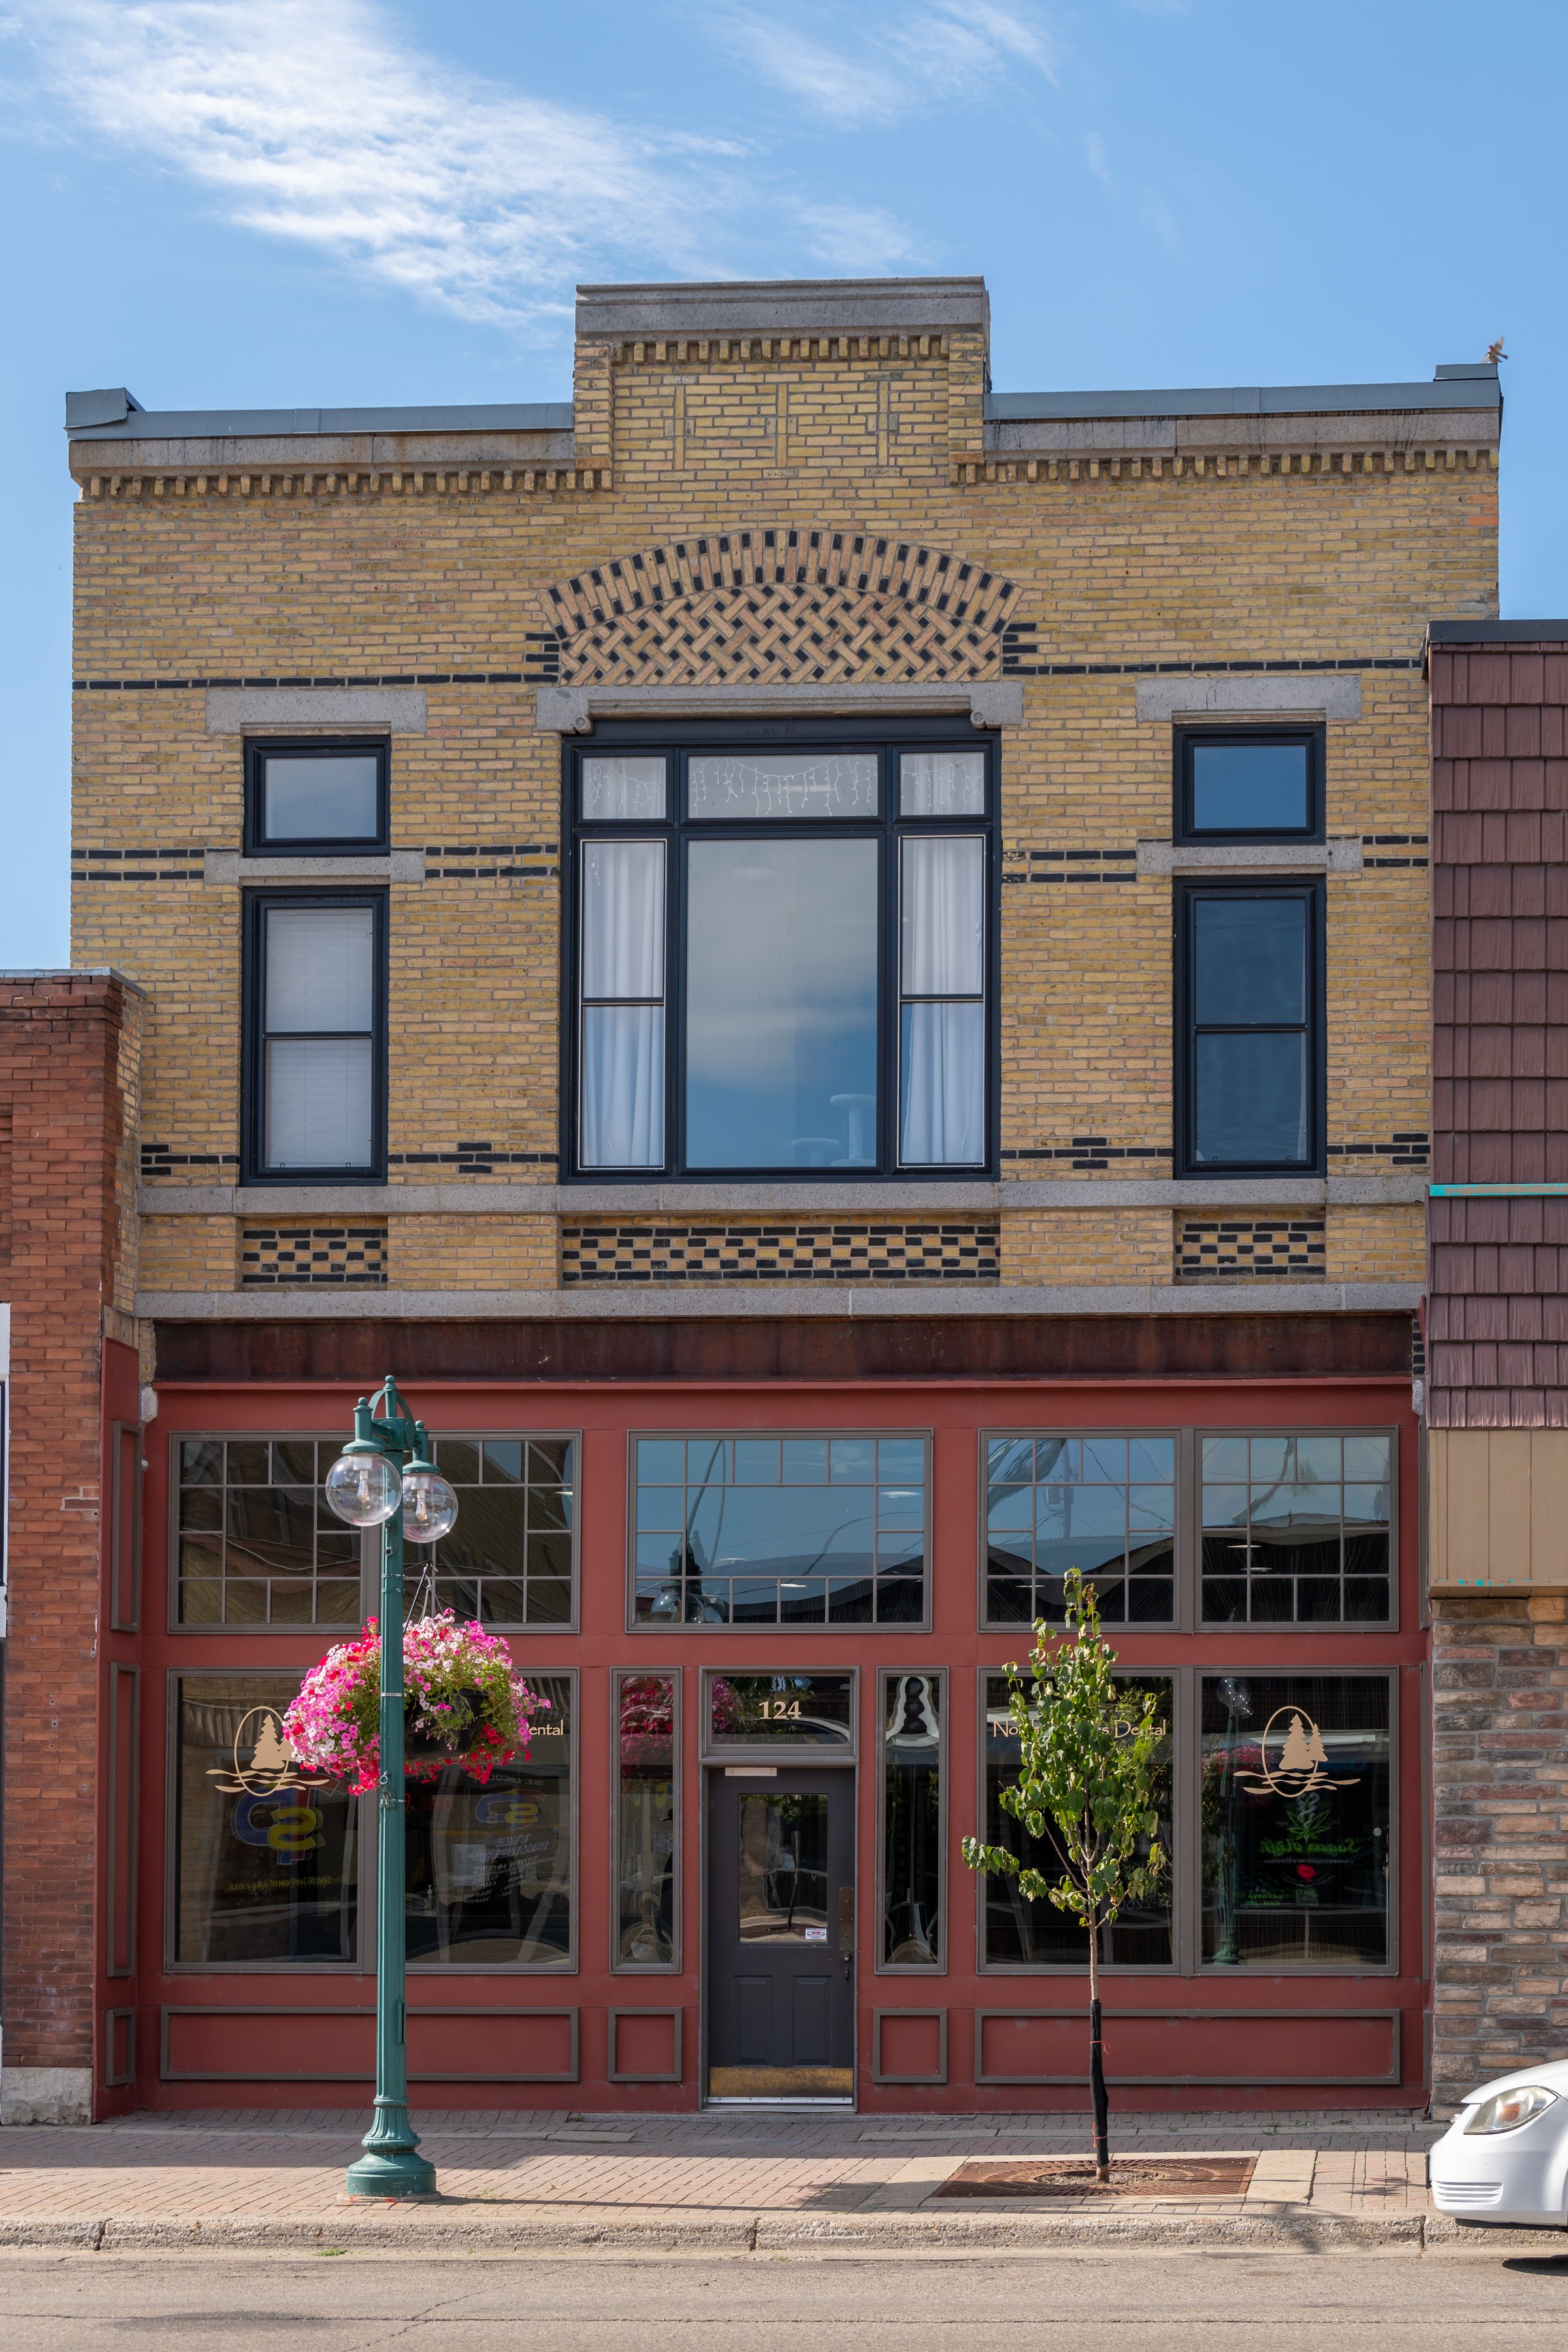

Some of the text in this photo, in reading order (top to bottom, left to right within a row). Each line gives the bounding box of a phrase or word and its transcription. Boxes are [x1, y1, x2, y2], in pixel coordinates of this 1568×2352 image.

[759, 1700, 802, 1719] 124
[527, 1719, 564, 1736] ental
[1113, 1719, 1166, 1738] Detal
